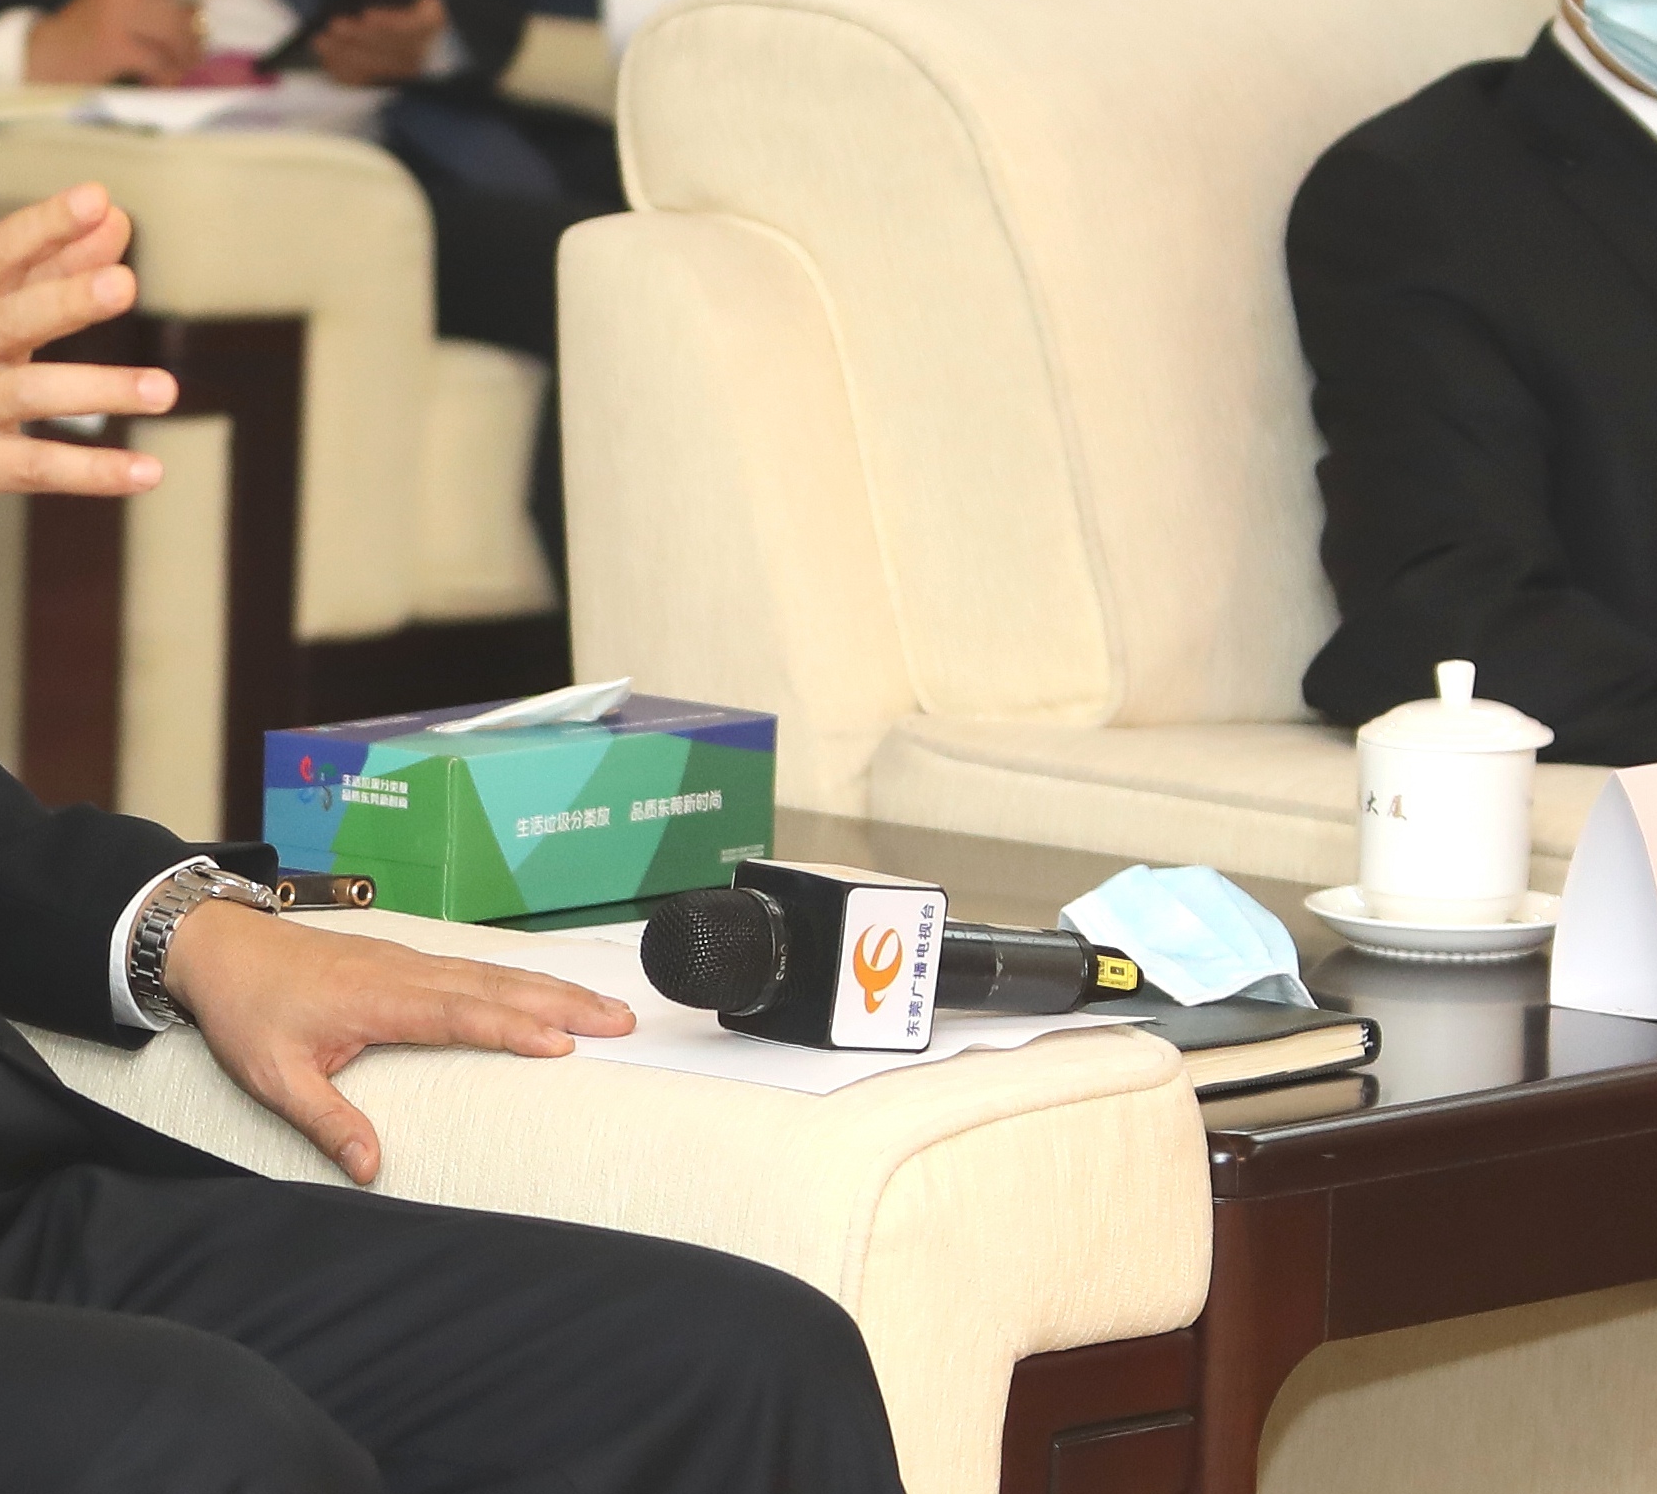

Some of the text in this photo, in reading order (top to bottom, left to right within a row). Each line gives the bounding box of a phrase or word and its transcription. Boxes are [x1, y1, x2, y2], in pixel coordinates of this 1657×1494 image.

[516, 789, 723, 839] 生活垃圾分类放 品质东莞新时尚
[905, 902, 936, 1039] 东莞广播电视台
